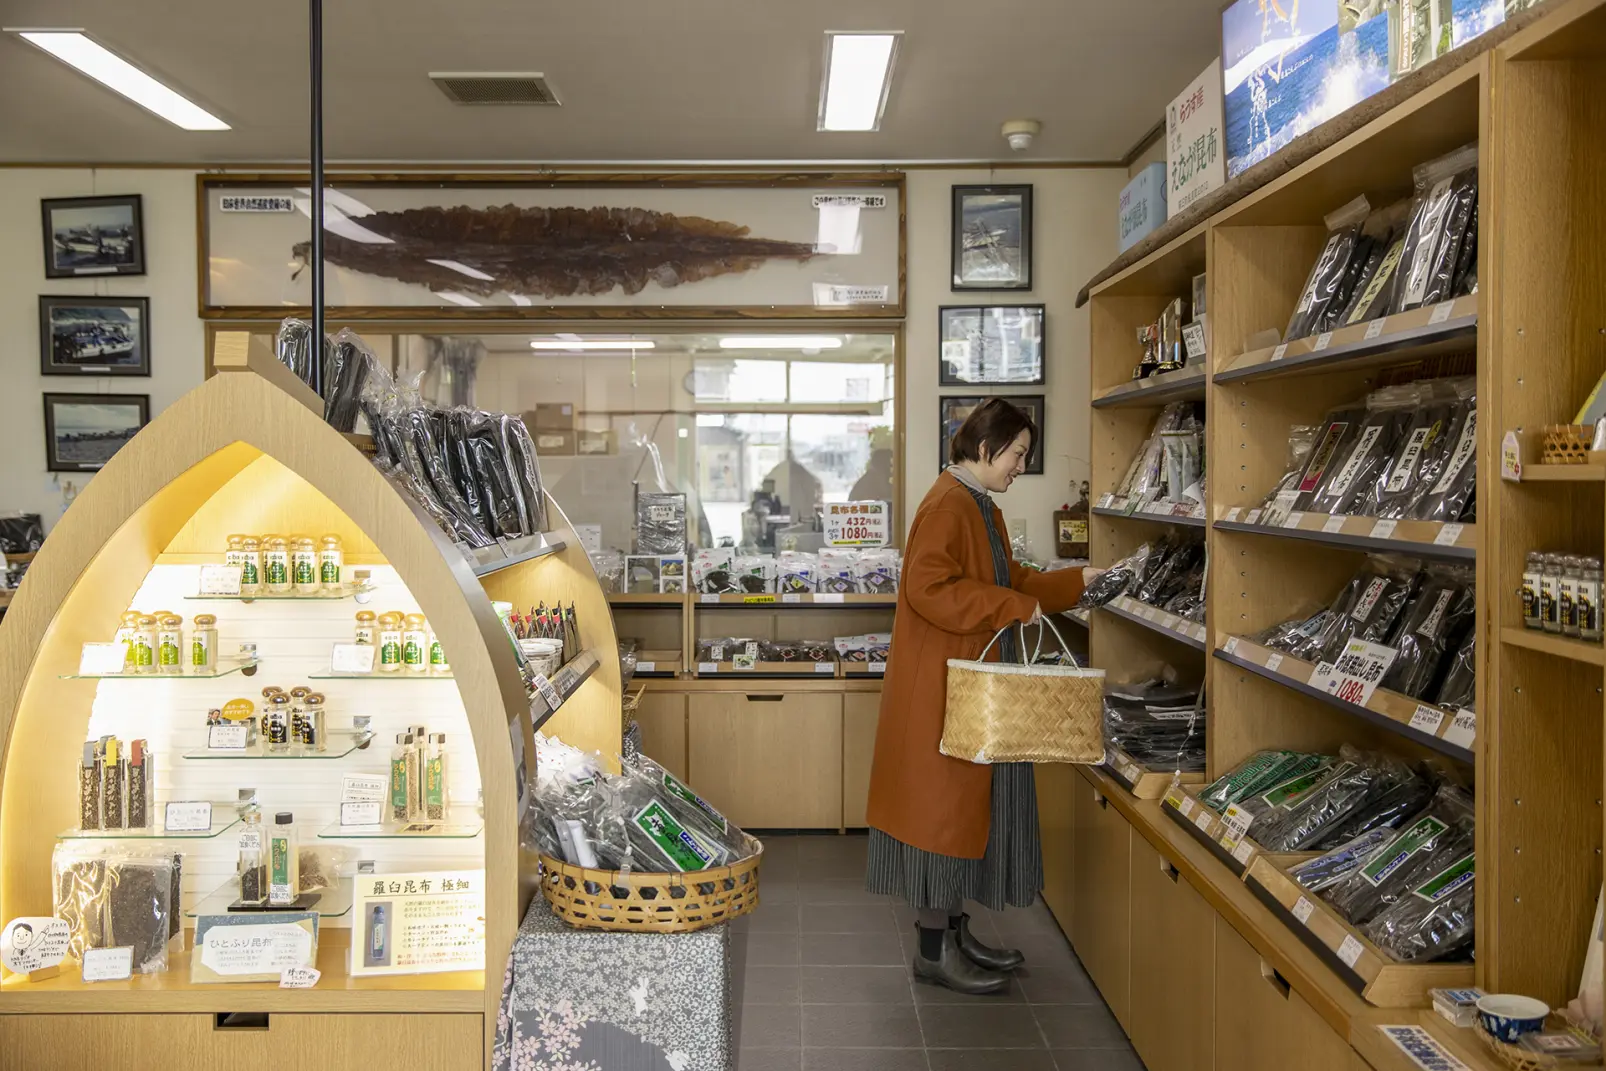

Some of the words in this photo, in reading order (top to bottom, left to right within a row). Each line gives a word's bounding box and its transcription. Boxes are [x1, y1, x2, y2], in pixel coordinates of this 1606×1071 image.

[1180, 85, 1204, 124] らうす産
[1171, 127, 1218, 194] えなが昆布
[830, 504, 869, 515] 昆布各種
[846, 516, 872, 526] 432円
[841, 527, 873, 539] 1080円
[373, 879, 433, 895] 羅臼昆布
[441, 877, 470, 892] 極細
[210, 936, 273, 949] ひとふり昆布
